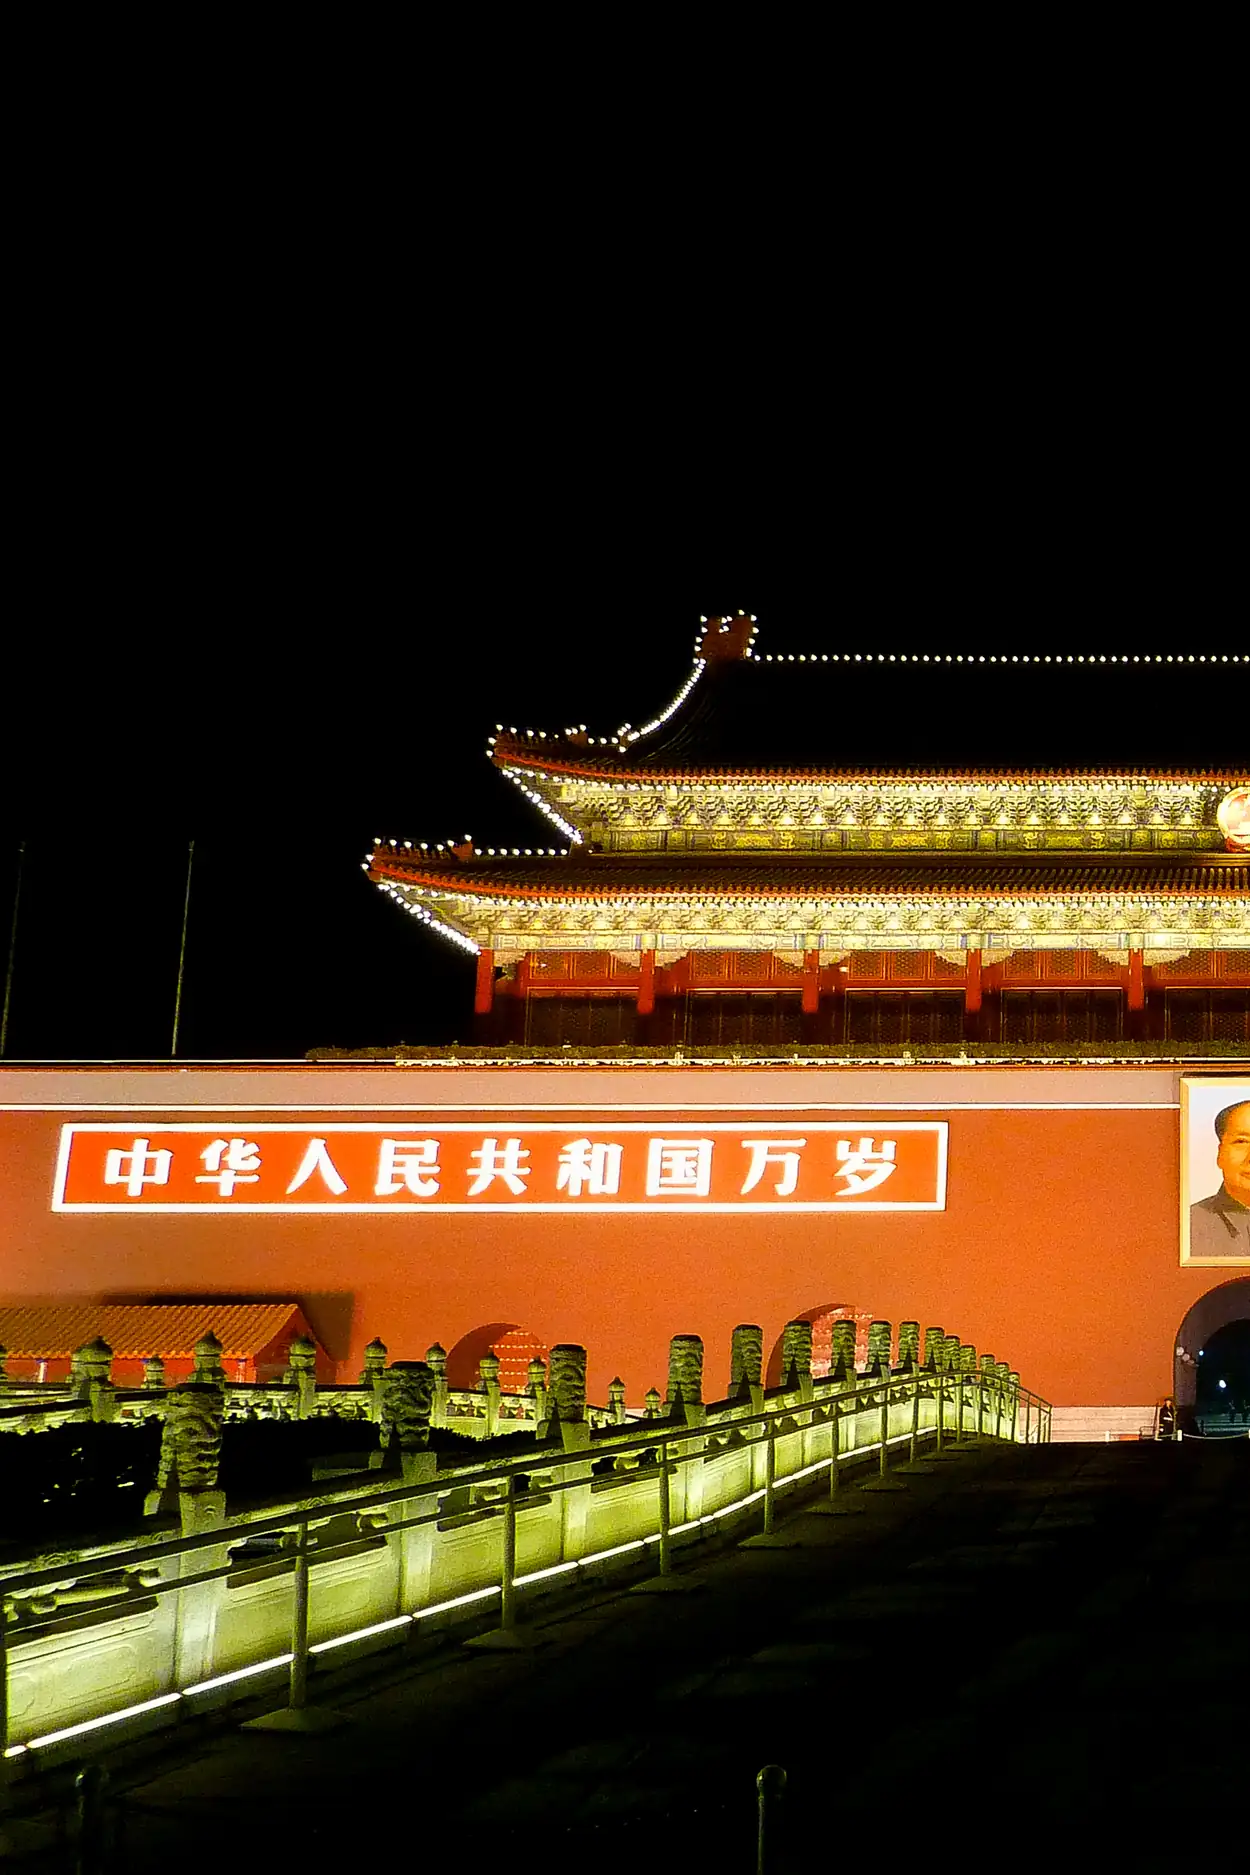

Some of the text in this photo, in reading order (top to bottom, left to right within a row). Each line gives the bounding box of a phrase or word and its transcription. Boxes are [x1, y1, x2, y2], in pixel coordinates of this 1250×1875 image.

[103, 1137, 897, 1197] 中华人民共和国万岁
